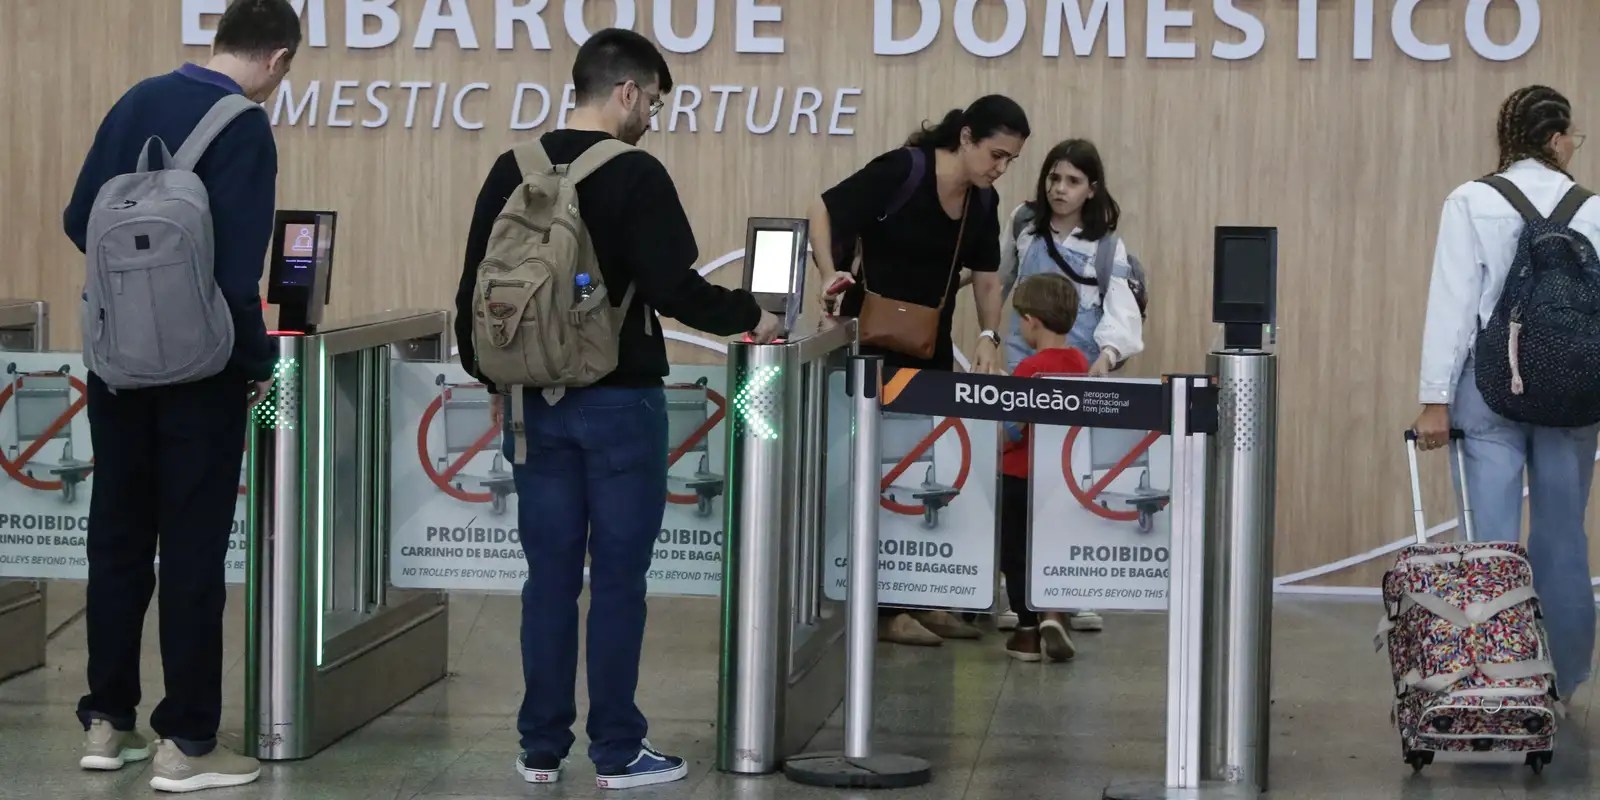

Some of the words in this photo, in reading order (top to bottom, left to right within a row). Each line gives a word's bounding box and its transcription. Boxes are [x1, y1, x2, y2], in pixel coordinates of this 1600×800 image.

[179, 0, 784, 53] EBARUE
[271, 80, 489, 130] MESTIC
[509, 82, 862, 135] DERTURE
[955, 382, 1080, 411] RIOgaleão
[1084, 391, 1119, 399] aeroporto
[1083, 398, 1129, 407] internacional
[1098, 406, 1119, 414] jobim
[0, 514, 89, 531] PROIBIDO
[0, 535, 34, 544] INHO
[37, 536, 51, 545] DE
[54, 536, 86, 546] BAGA
[427, 526, 520, 543] PROIBIDO
[657, 529, 723, 546] OIBIDO
[401, 546, 463, 558] CARRINHO
[466, 548, 480, 558] DE
[483, 549, 526, 559] BAGAG
[878, 539, 953, 558] OIBIDO
[1070, 545, 1169, 562] PROIBIDO
[0, 555, 30, 564] OLLEYS
[32, 556, 66, 565] BEYOND
[68, 557, 87, 566] THIS
[671, 550, 687, 560] DE
[688, 550, 722, 561] BAGA
[402, 568, 417, 576] NO
[418, 568, 458, 577] TROLLEYS
[461, 569, 497, 579] BEYOND
[498, 570, 517, 579] THIS
[898, 561, 913, 571] DE
[915, 562, 978, 576] BAGAGENS
[1043, 566, 1107, 577] CARRINHO
[1111, 567, 1126, 578] DE
[1129, 568, 1169, 578] BAGAG
[665, 570, 702, 581] BEYOND
[703, 572, 722, 581] THIS
[892, 582, 928, 593] BEYOND
[929, 584, 948, 594] THIS
[949, 585, 976, 596] POINT
[1044, 587, 1059, 596] NO
[1060, 587, 1102, 597] TROLLEYS
[1105, 588, 1142, 598] BEYOND
[1144, 589, 1164, 598] THIS
